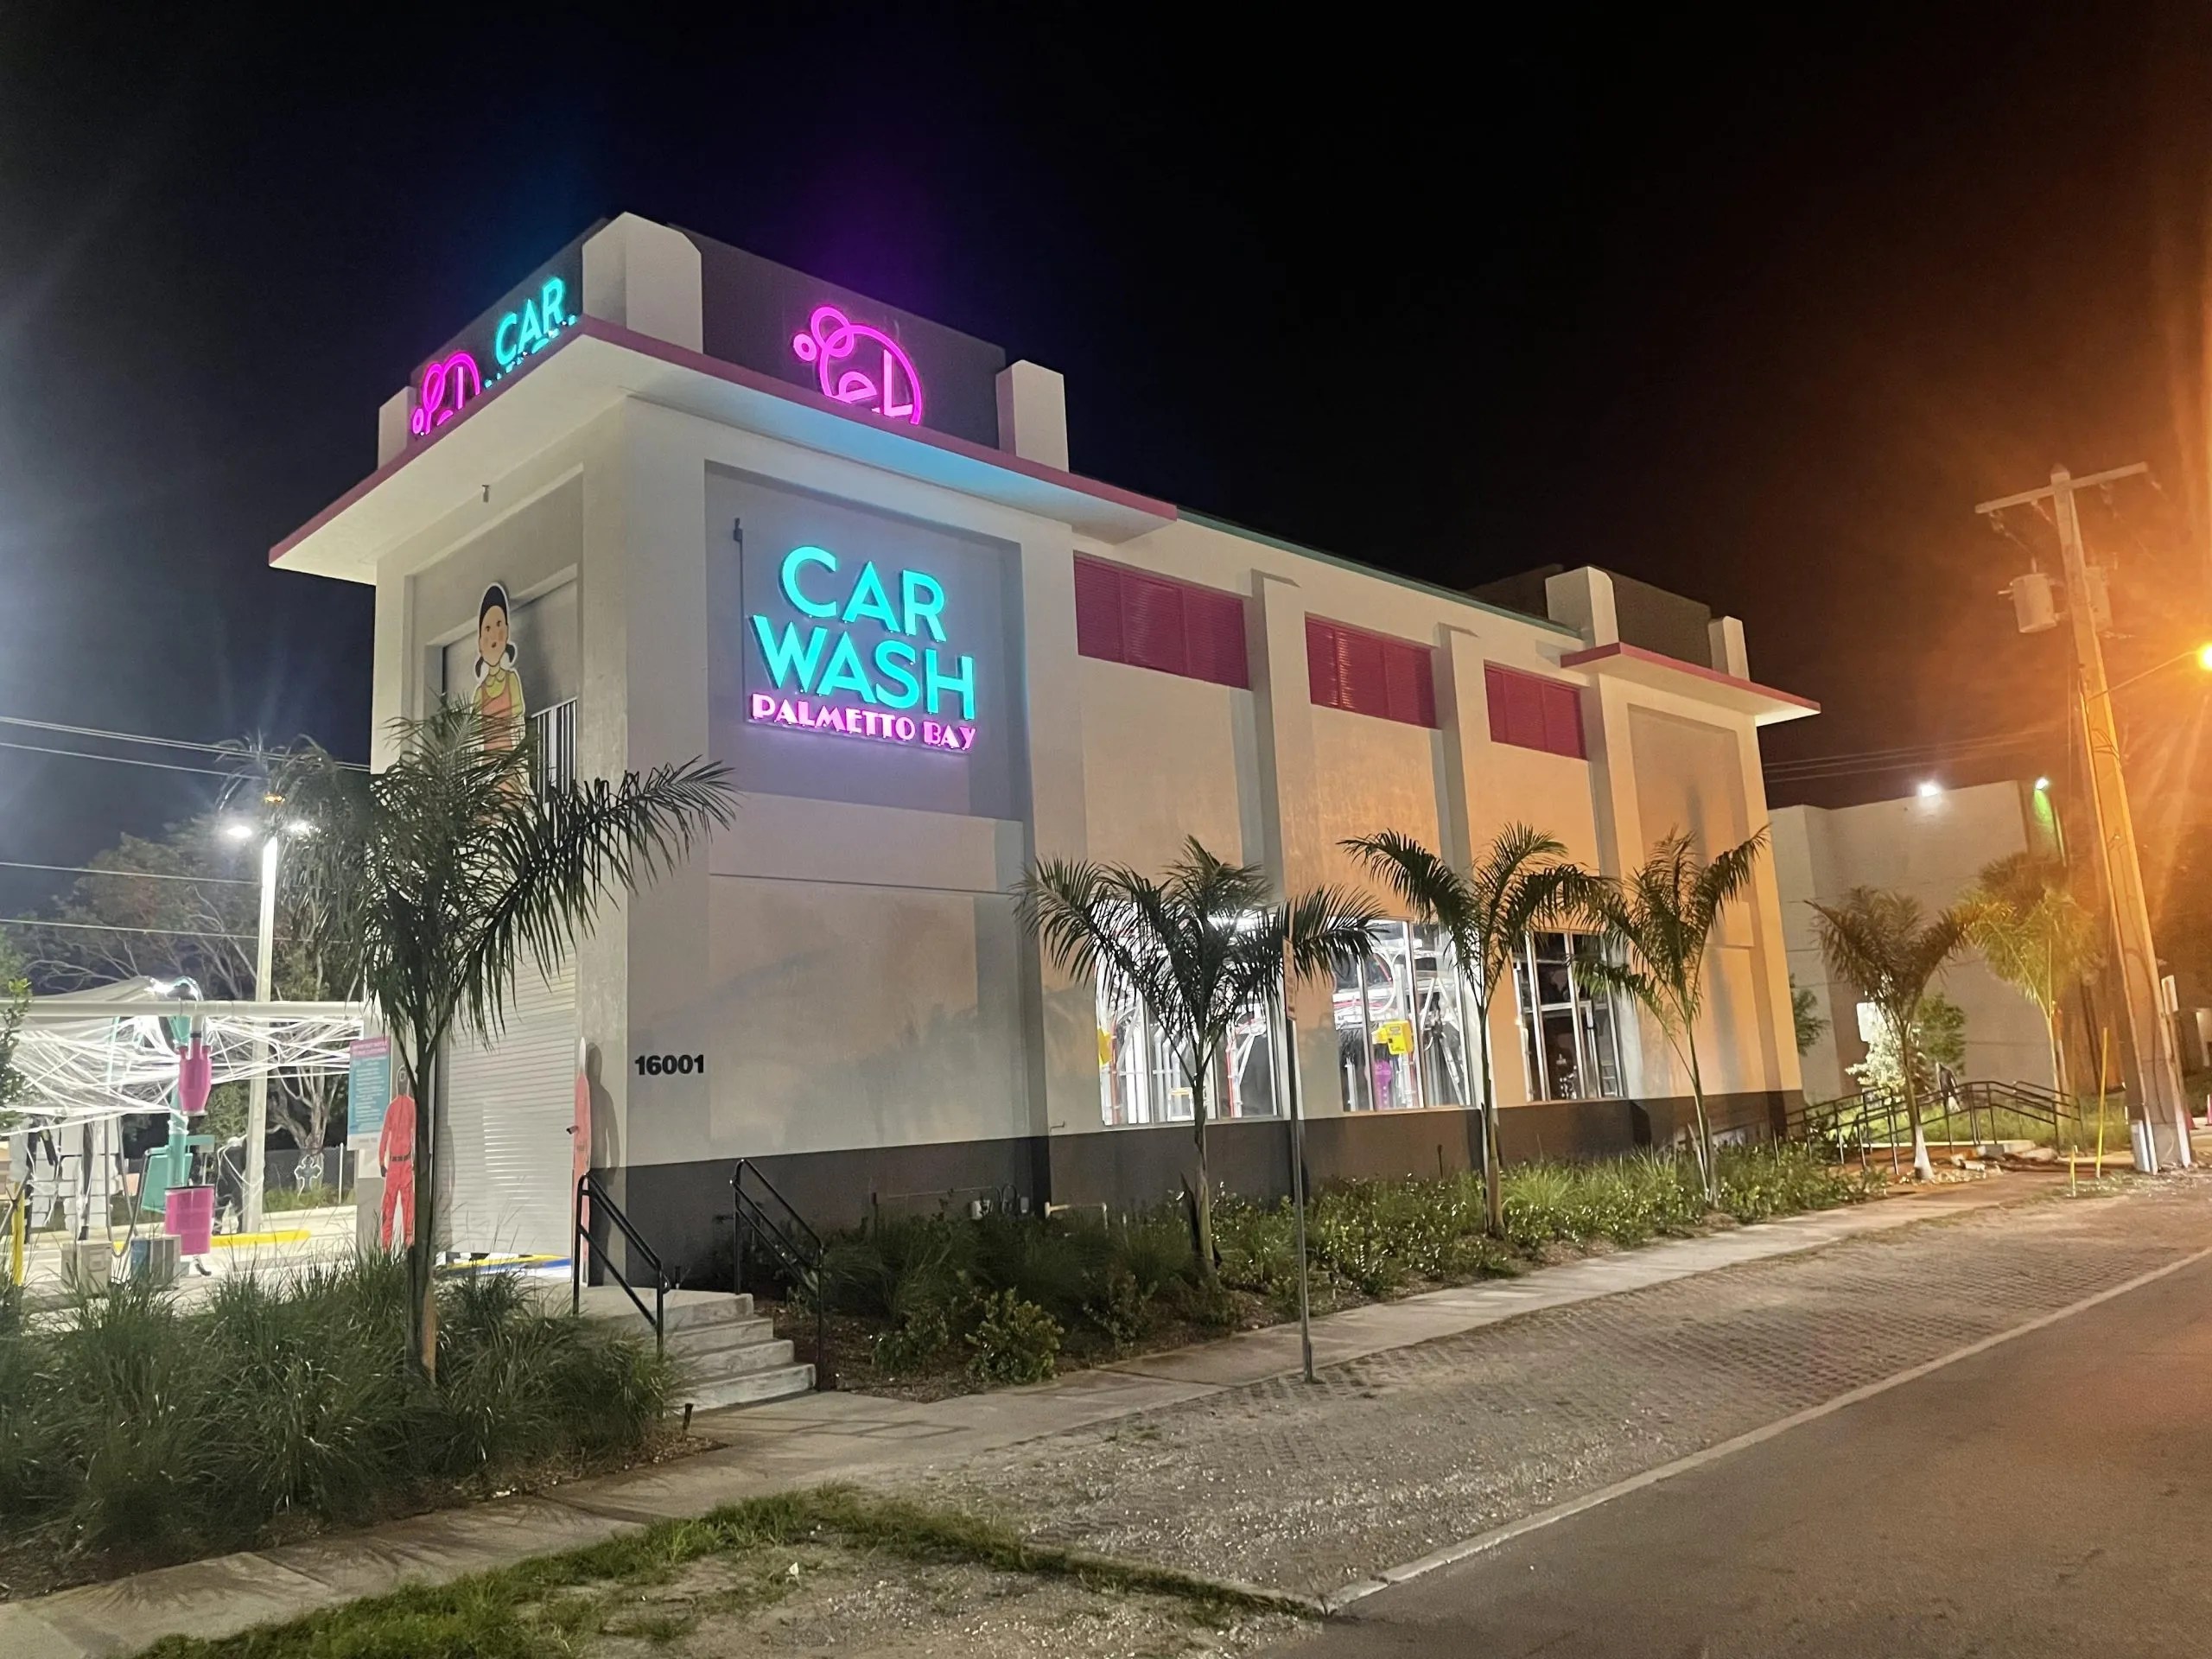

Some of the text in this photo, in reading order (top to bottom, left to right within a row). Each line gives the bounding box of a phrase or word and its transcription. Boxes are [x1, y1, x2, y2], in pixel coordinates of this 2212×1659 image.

[495, 276, 565, 365] CAR
[780, 545, 947, 643] CAR
[752, 614, 976, 720] WASH
[751, 693, 977, 751] PALMETTO BAY
[635, 1054, 704, 1076] 16001
